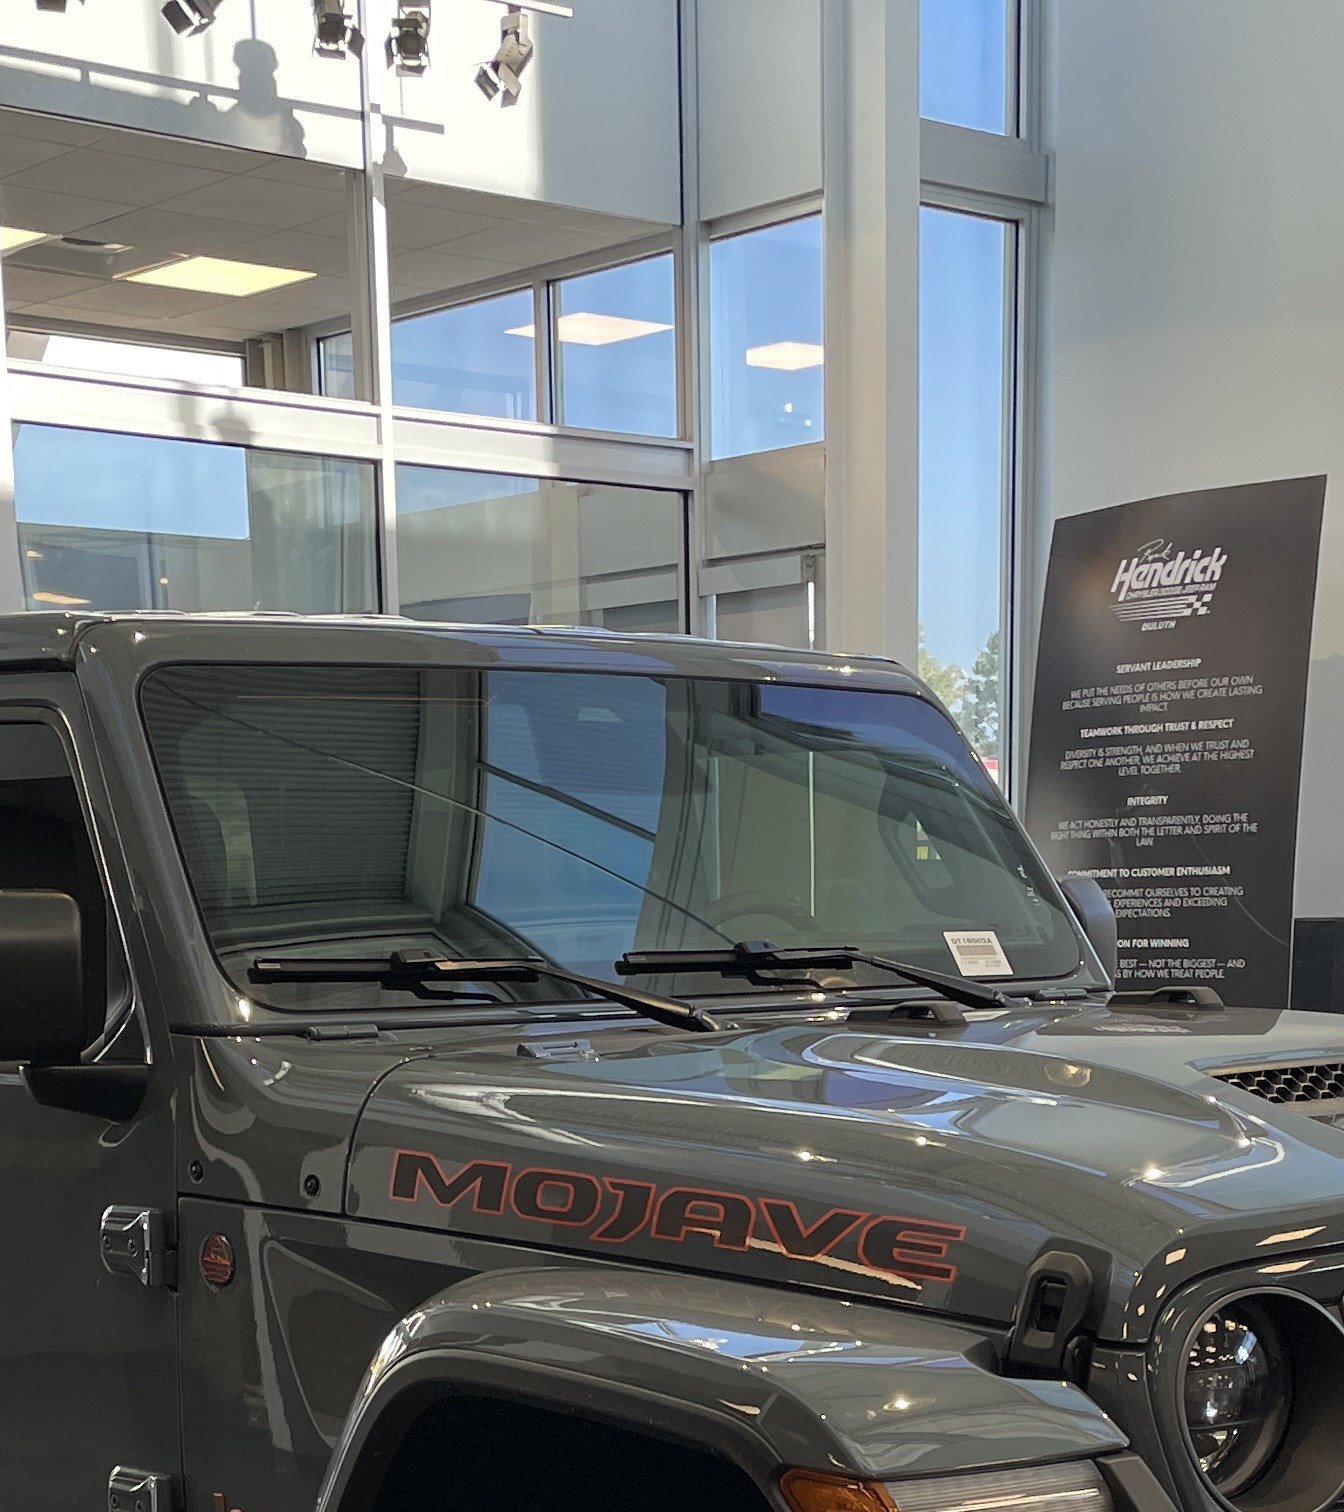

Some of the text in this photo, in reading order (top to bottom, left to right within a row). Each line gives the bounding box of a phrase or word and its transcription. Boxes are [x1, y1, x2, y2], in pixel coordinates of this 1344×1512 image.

[1111, 547, 1228, 601] Hendrick
[1141, 621, 1176, 632] DULUTH
[1116, 658, 1202, 674] SERVANT LEADERSHIP
[1110, 683, 1133, 695] NEEDS
[1134, 682, 1145, 693] OF
[1147, 681, 1176, 691] OTHERS
[1178, 678, 1208, 690] BEFORE
[1210, 676, 1229, 687] OUR
[1231, 675, 1254, 686] OWN
[1062, 685, 1263, 711] BECAUSE SERVING PEOPLE IS HOW WE CREATE LASTING
[1080, 718, 1235, 738] TEAMWORK THROUGH TRUST & RESPECT
[1065, 748, 1097, 760] DIVERSITY
[1097, 747, 1105, 757] IS
[1145, 743, 1163, 753] AND
[1163, 742, 1190, 752] WHEN
[1190, 741, 1204, 751] WE
[1205, 740, 1230, 750] TRUST
[1230, 739, 1250, 749] AND
[1060, 759, 1087, 771] RESPECT
[1088, 757, 1104, 768] ONE
[1142, 754, 1155, 764] WE
[1156, 752, 1191, 763] ACHIEVE
[1191, 751, 1202, 761] AT
[1203, 750, 1219, 760] THE
[1220, 748, 1255, 760] HIGHEST
[1118, 765, 1139, 777] LEVEL
[1127, 795, 1169, 806] INTEGRITY
[1058, 821, 1069, 830] WE
[1069, 819, 1083, 829] ACT
[1083, 818, 1119, 829] HONESTLY
[1119, 817, 1137, 827] AND
[1202, 813, 1232, 824] DOING
[1232, 812, 1249, 822] THE
[1050, 822, 1258, 840] RIGHT THING WITHIN BOTH THE LETTER AND SPIRIT OF THE
[1118, 867, 1130, 878] TO
[1131, 867, 1176, 878] CUSTOMER
[1176, 865, 1231, 876] ENTHUSIASM
[1144, 887, 1189, 898] OURSELVES
[1190, 887, 1202, 897] TO
[1202, 885, 1244, 896] CREATING
[1113, 896, 1228, 908] EXPERIENCES AND EXCEEDING
[1131, 939, 1149, 948] FOR
[1149, 938, 1190, 948] WINNING
[1119, 959, 1138, 968] BEST
[1148, 959, 1166, 968] NOT
[1166, 958, 1182, 968] THE
[1182, 958, 1216, 968] BIGGEST
[1226, 958, 1246, 968] AND
[1122, 969, 1133, 978] BY
[1134, 969, 1155, 978] HOW
[1155, 969, 1170, 978] WE
[1170, 969, 1195, 978] TREAT
[390, 1149, 966, 1282] MOJAVE
